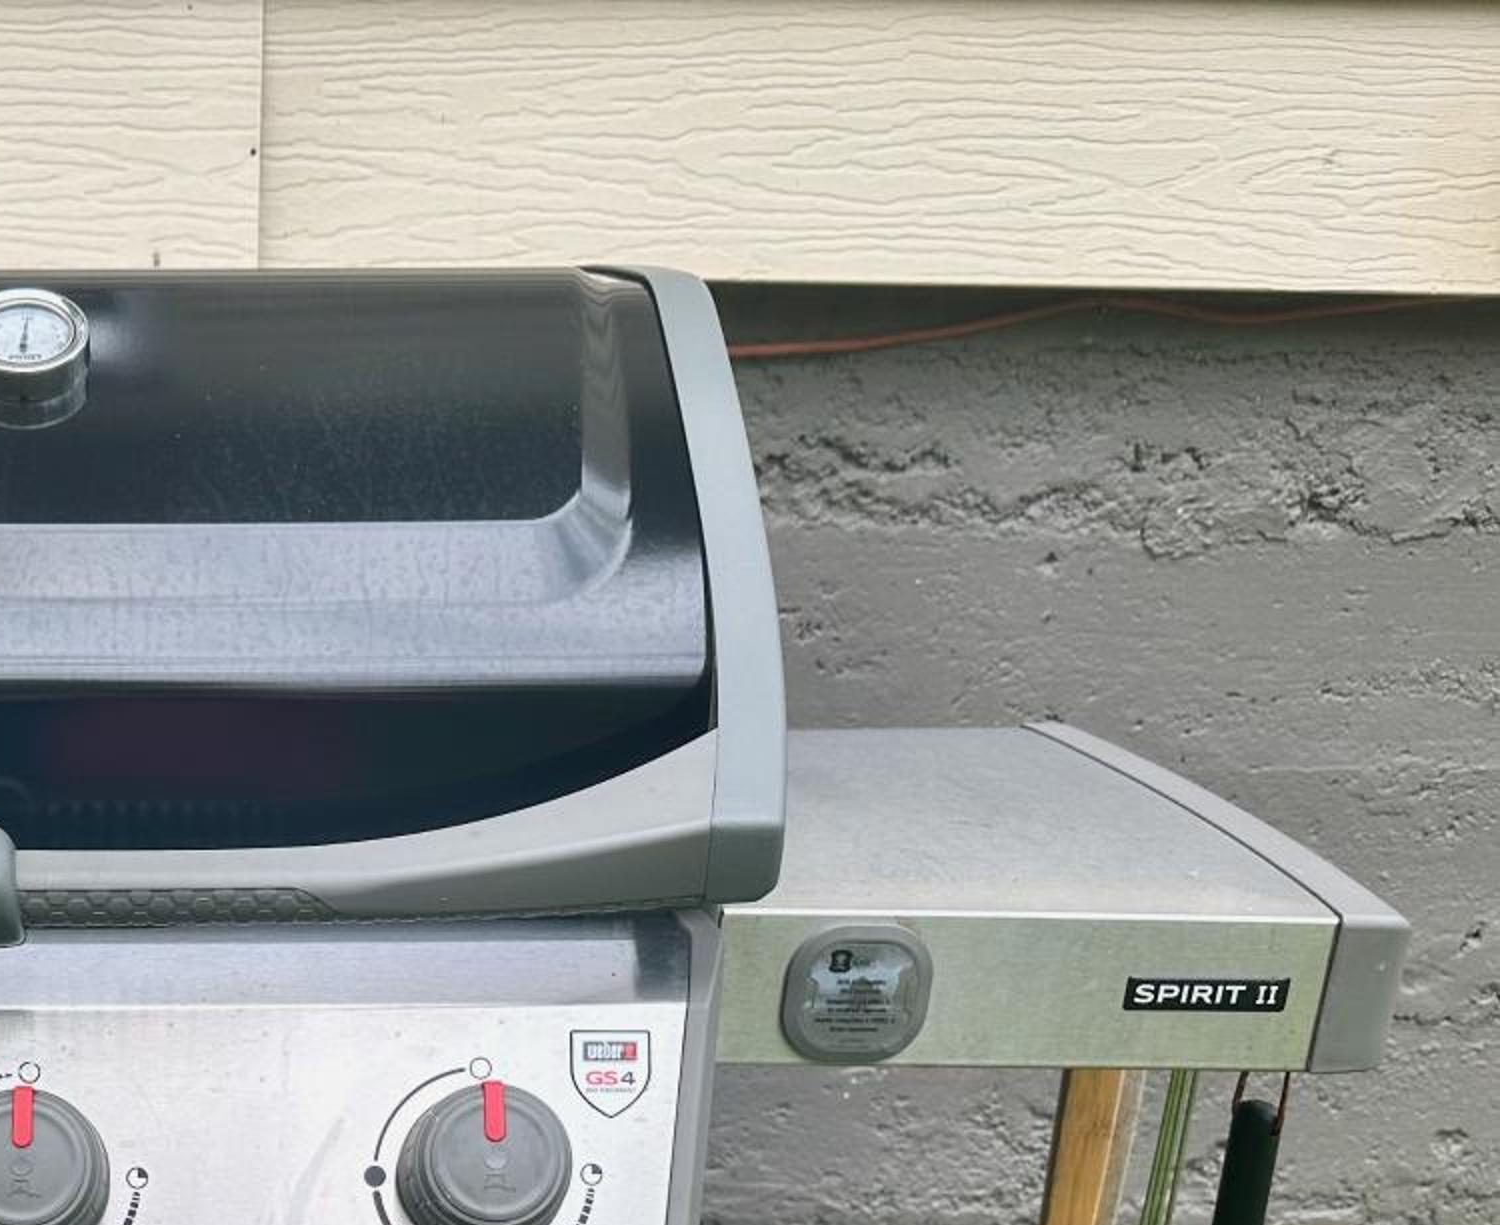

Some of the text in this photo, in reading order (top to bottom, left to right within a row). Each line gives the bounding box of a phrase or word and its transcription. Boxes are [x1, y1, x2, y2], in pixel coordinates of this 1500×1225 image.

[1133, 983, 1280, 1006] SPIRIT II
[585, 1070, 637, 1086] GS4
